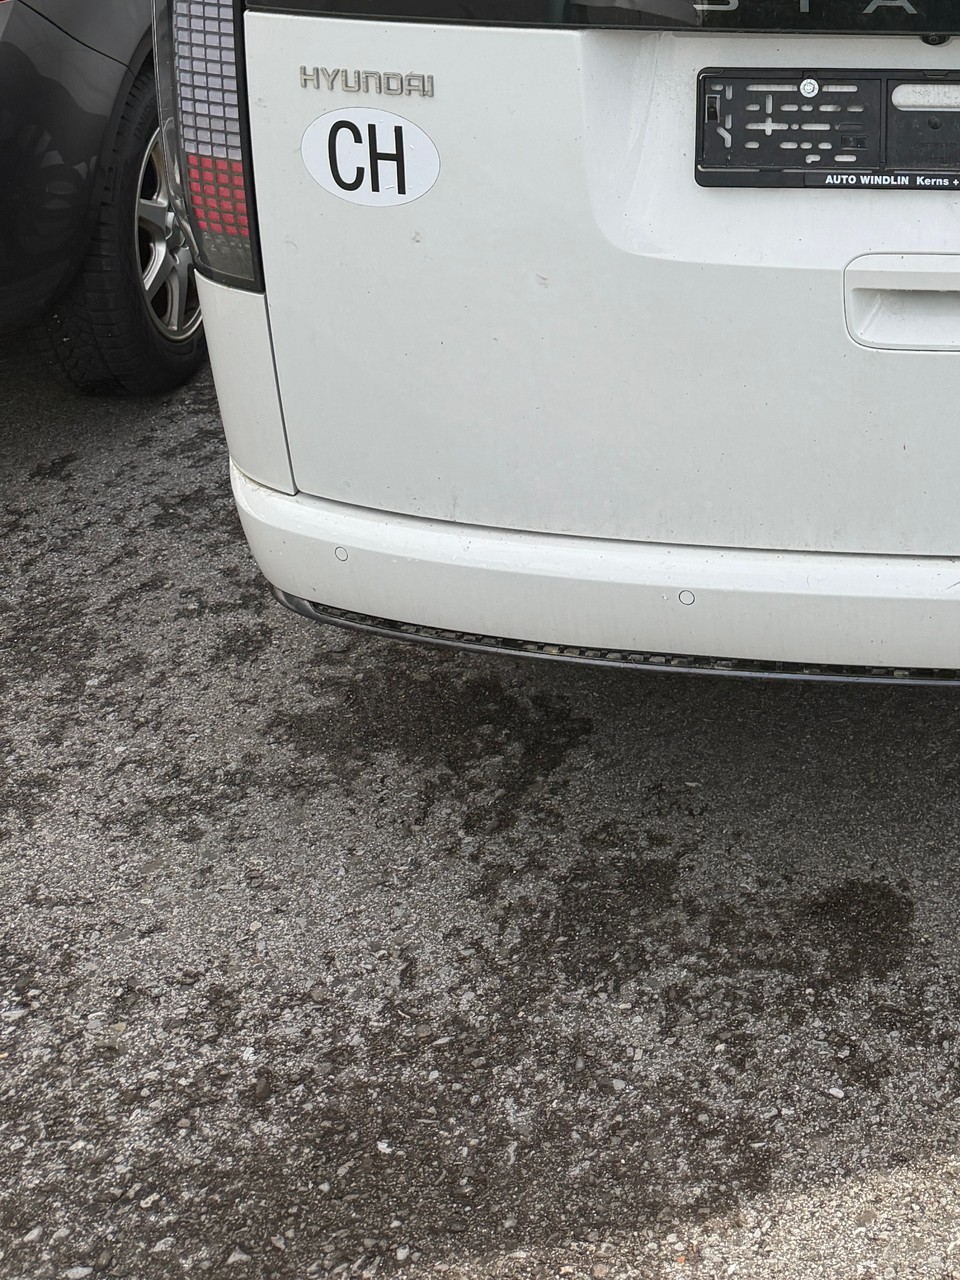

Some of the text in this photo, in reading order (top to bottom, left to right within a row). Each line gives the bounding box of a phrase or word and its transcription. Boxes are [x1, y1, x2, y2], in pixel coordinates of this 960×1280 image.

[299, 65, 434, 98] HYUNDAI
[328, 119, 406, 195] CH
[825, 174, 857, 185] AUTO
[860, 175, 909, 186] WINDLIN
[916, 176, 949, 186] Kerns
